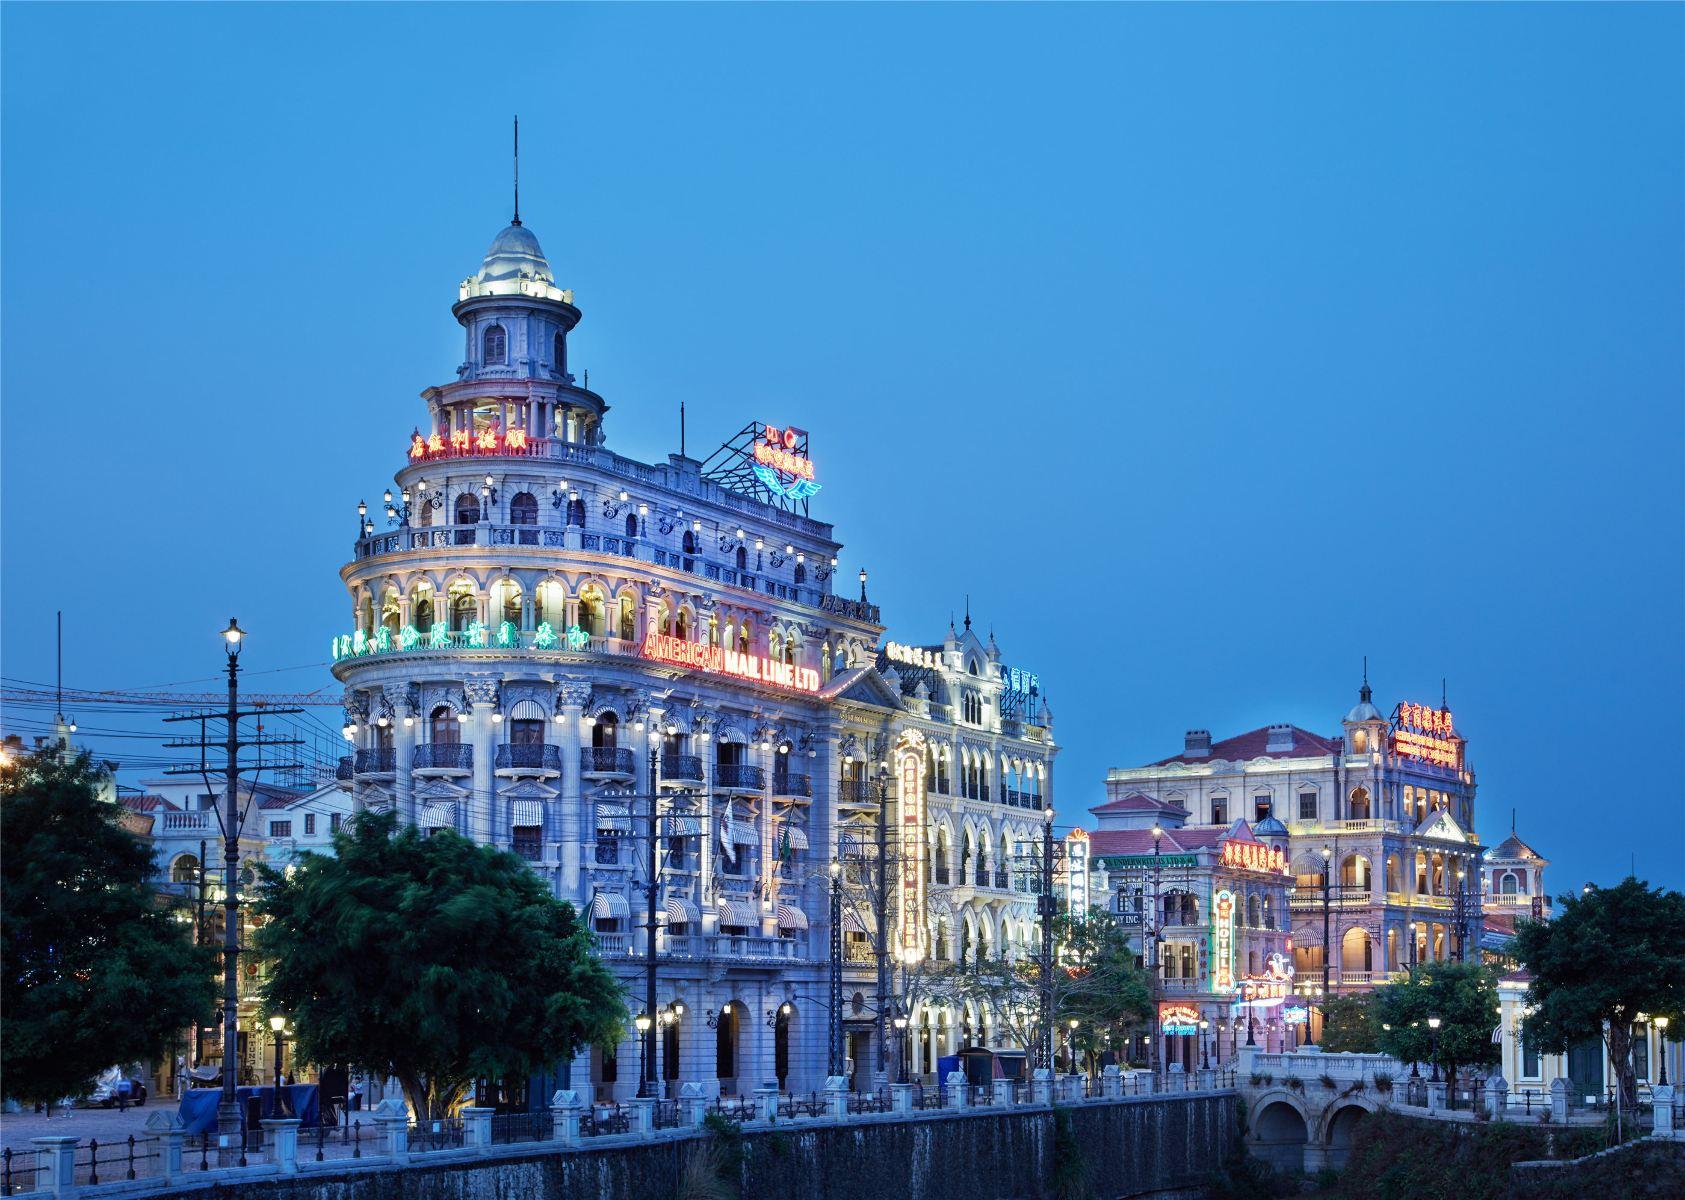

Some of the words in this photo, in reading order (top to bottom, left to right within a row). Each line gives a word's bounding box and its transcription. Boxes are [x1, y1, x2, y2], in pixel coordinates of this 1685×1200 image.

[644, 632, 724, 671] AMERICAN
[724, 649, 761, 680] MAIL
[761, 658, 794, 687] LINE
[793, 664, 819, 692] LTD
[905, 758, 916, 816] ASTOR
[905, 887, 916, 947] HOTEL
[1125, 915, 1140, 924] INC.
[1219, 919, 1230, 968] HOTEL
